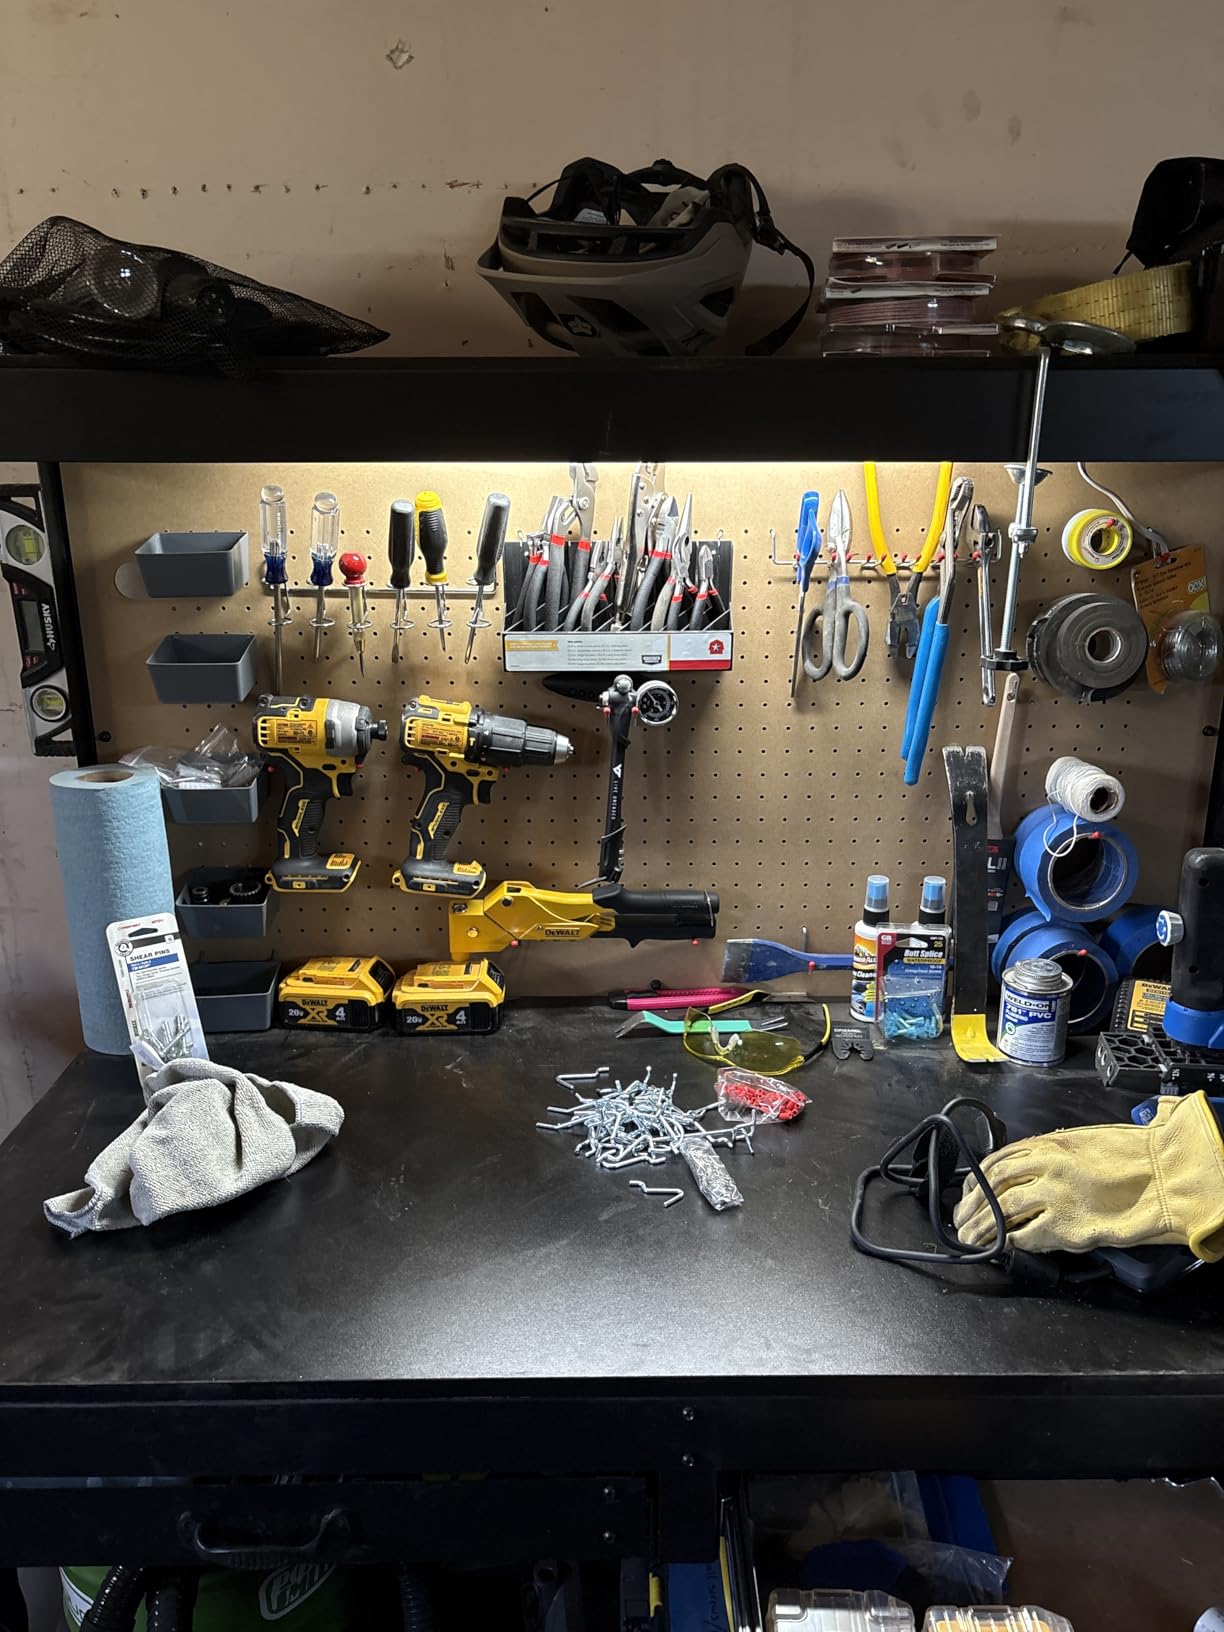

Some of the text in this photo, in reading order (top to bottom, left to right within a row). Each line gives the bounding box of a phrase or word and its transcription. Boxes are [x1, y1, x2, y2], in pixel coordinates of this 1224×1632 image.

[41, 603, 55, 639] HUSKY
[130, 952, 153, 961] SHEAR
[904, 949, 943, 958] Butt Splice
[302, 999, 328, 1007] DEWALT
[336, 1007, 346, 1017] 4
[456, 1010, 466, 1020] 4
[1028, 1011, 1052, 1019] PVC
